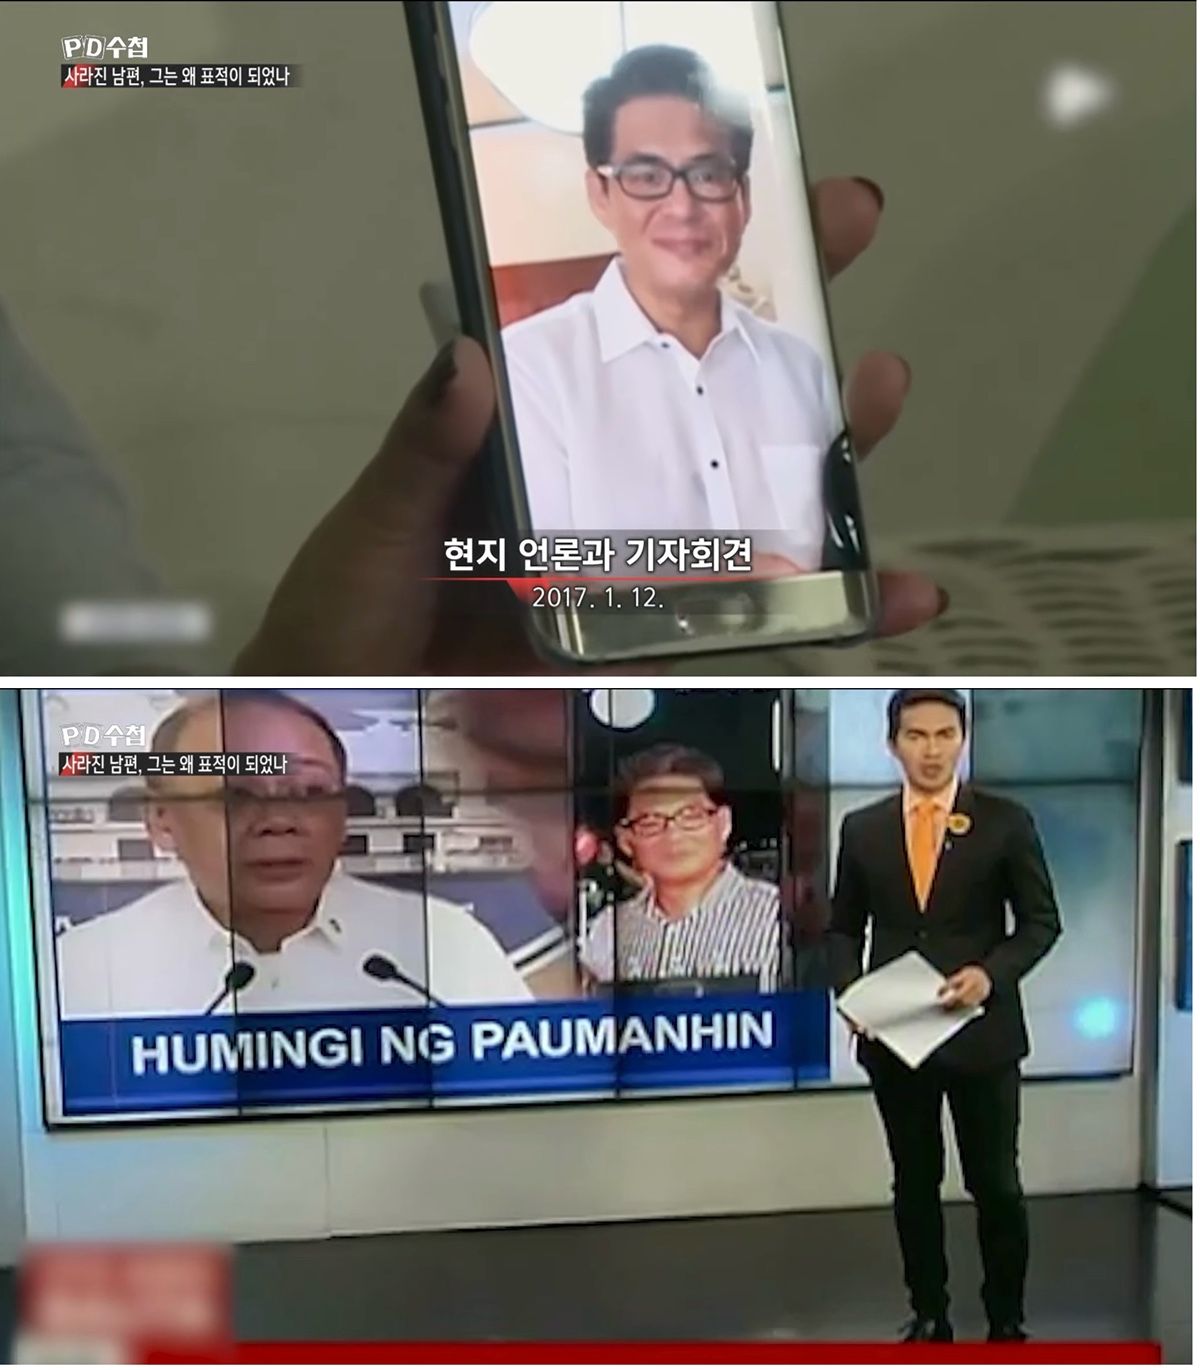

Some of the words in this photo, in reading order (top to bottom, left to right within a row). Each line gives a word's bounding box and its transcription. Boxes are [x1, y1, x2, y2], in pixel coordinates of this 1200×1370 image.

[132, 1027, 363, 1076] HUMINGI
[381, 1024, 454, 1065] NG
[472, 1010, 774, 1061] PAUMANHIN
